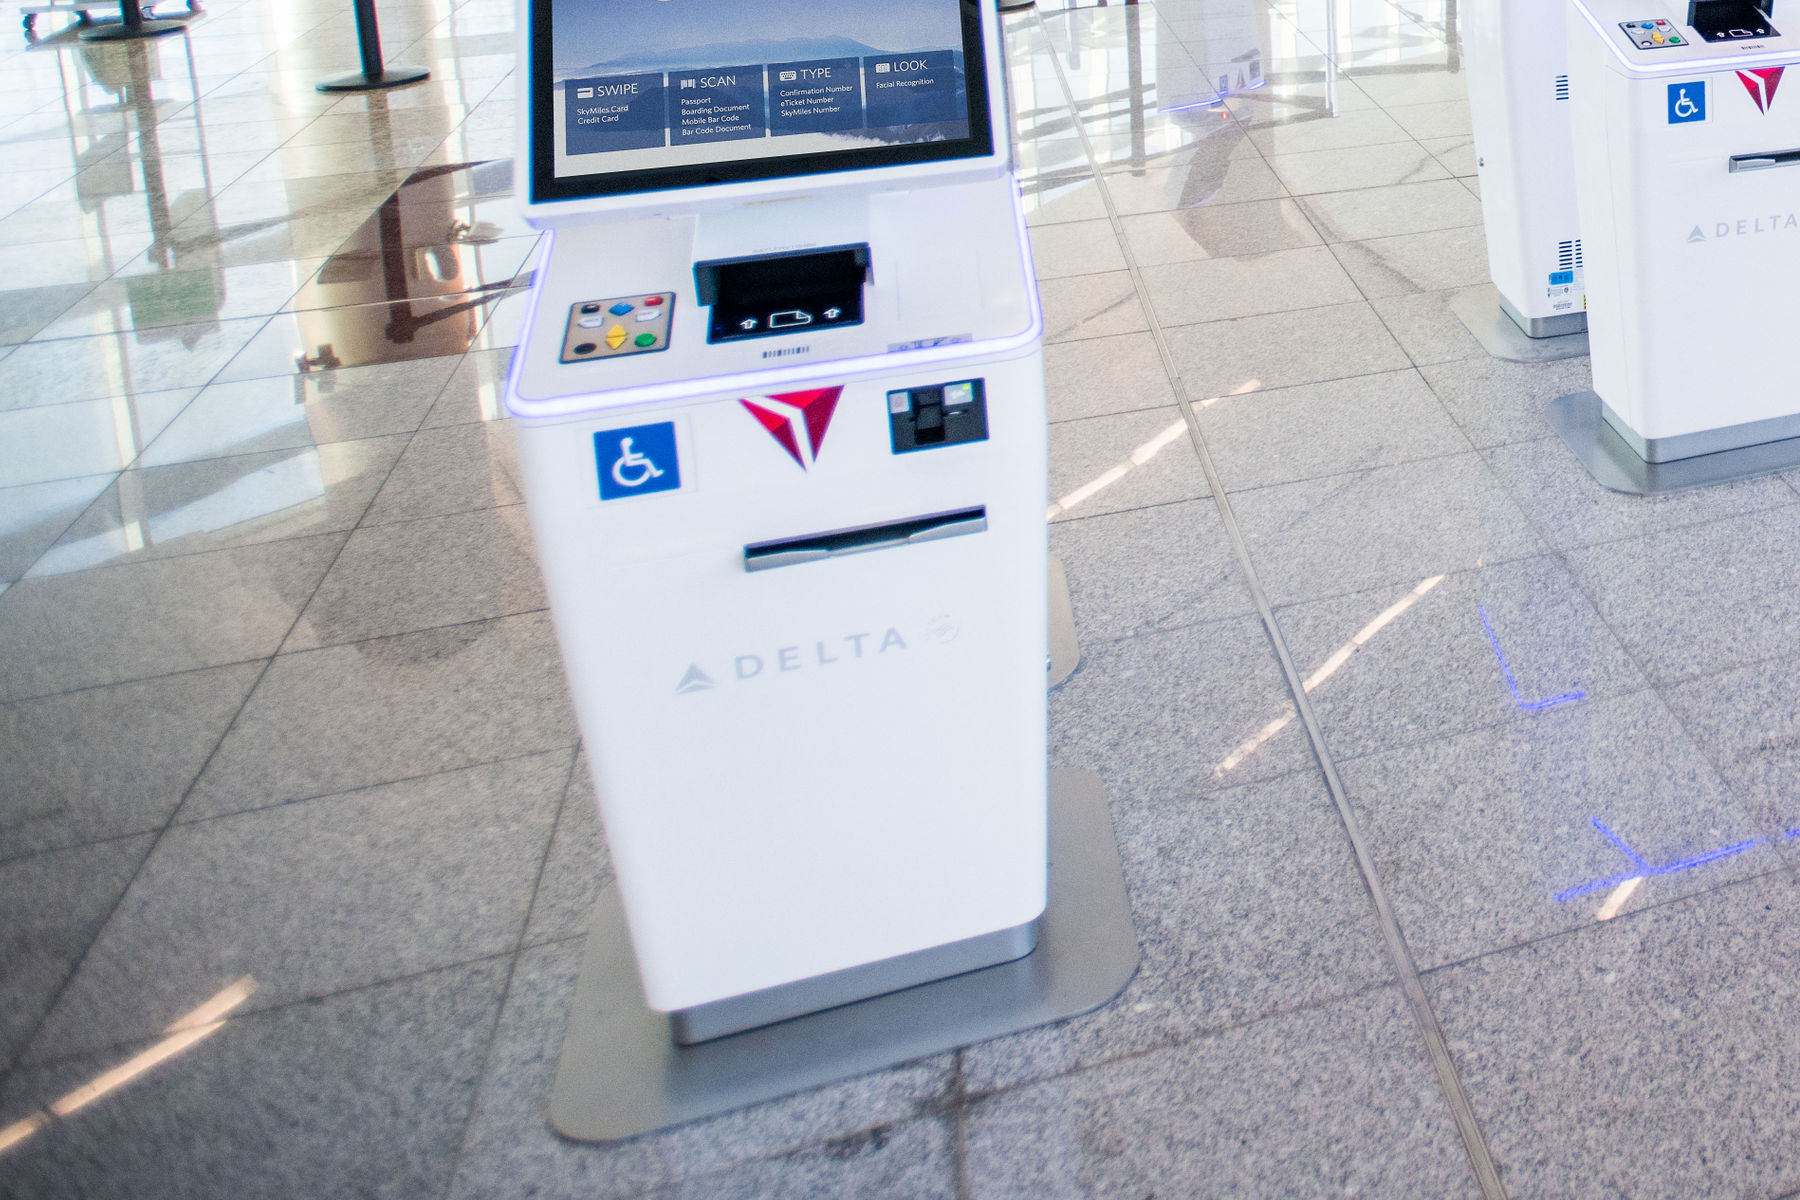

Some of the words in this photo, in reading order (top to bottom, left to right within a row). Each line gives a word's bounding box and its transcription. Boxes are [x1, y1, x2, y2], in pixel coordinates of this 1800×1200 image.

[893, 59, 928, 73] LOOK
[800, 67, 832, 80] TYPE
[700, 75, 736, 89] SCAN
[876, 81, 895, 89] Facial
[896, 78, 934, 88] Recognition
[597, 83, 639, 97] SWIPE
[780, 87, 825, 98] Confirmation
[826, 84, 853, 94] Number
[681, 96, 712, 106] Passport
[780, 98, 806, 108] eTicket
[806, 96, 834, 105] Number
[577, 106, 610, 116] SkyMiles
[611, 104, 629, 113] Card
[681, 106, 712, 116] Boarding
[714, 103, 750, 113] Document
[781, 107, 812, 117] SkyMiles
[813, 105, 841, 114] Number
[577, 116, 600, 125] Credit
[601, 114, 619, 123] Card
[682, 117, 706, 126] Mobile
[707, 116, 720, 124] Bar
[721, 114, 740, 123] Code
[682, 128, 695, 136] Bar
[695, 126, 714, 135] Code
[715, 123, 752, 133] Document
[1715, 212, 1799, 239] DELTA
[734, 626, 908, 682] DELTA
